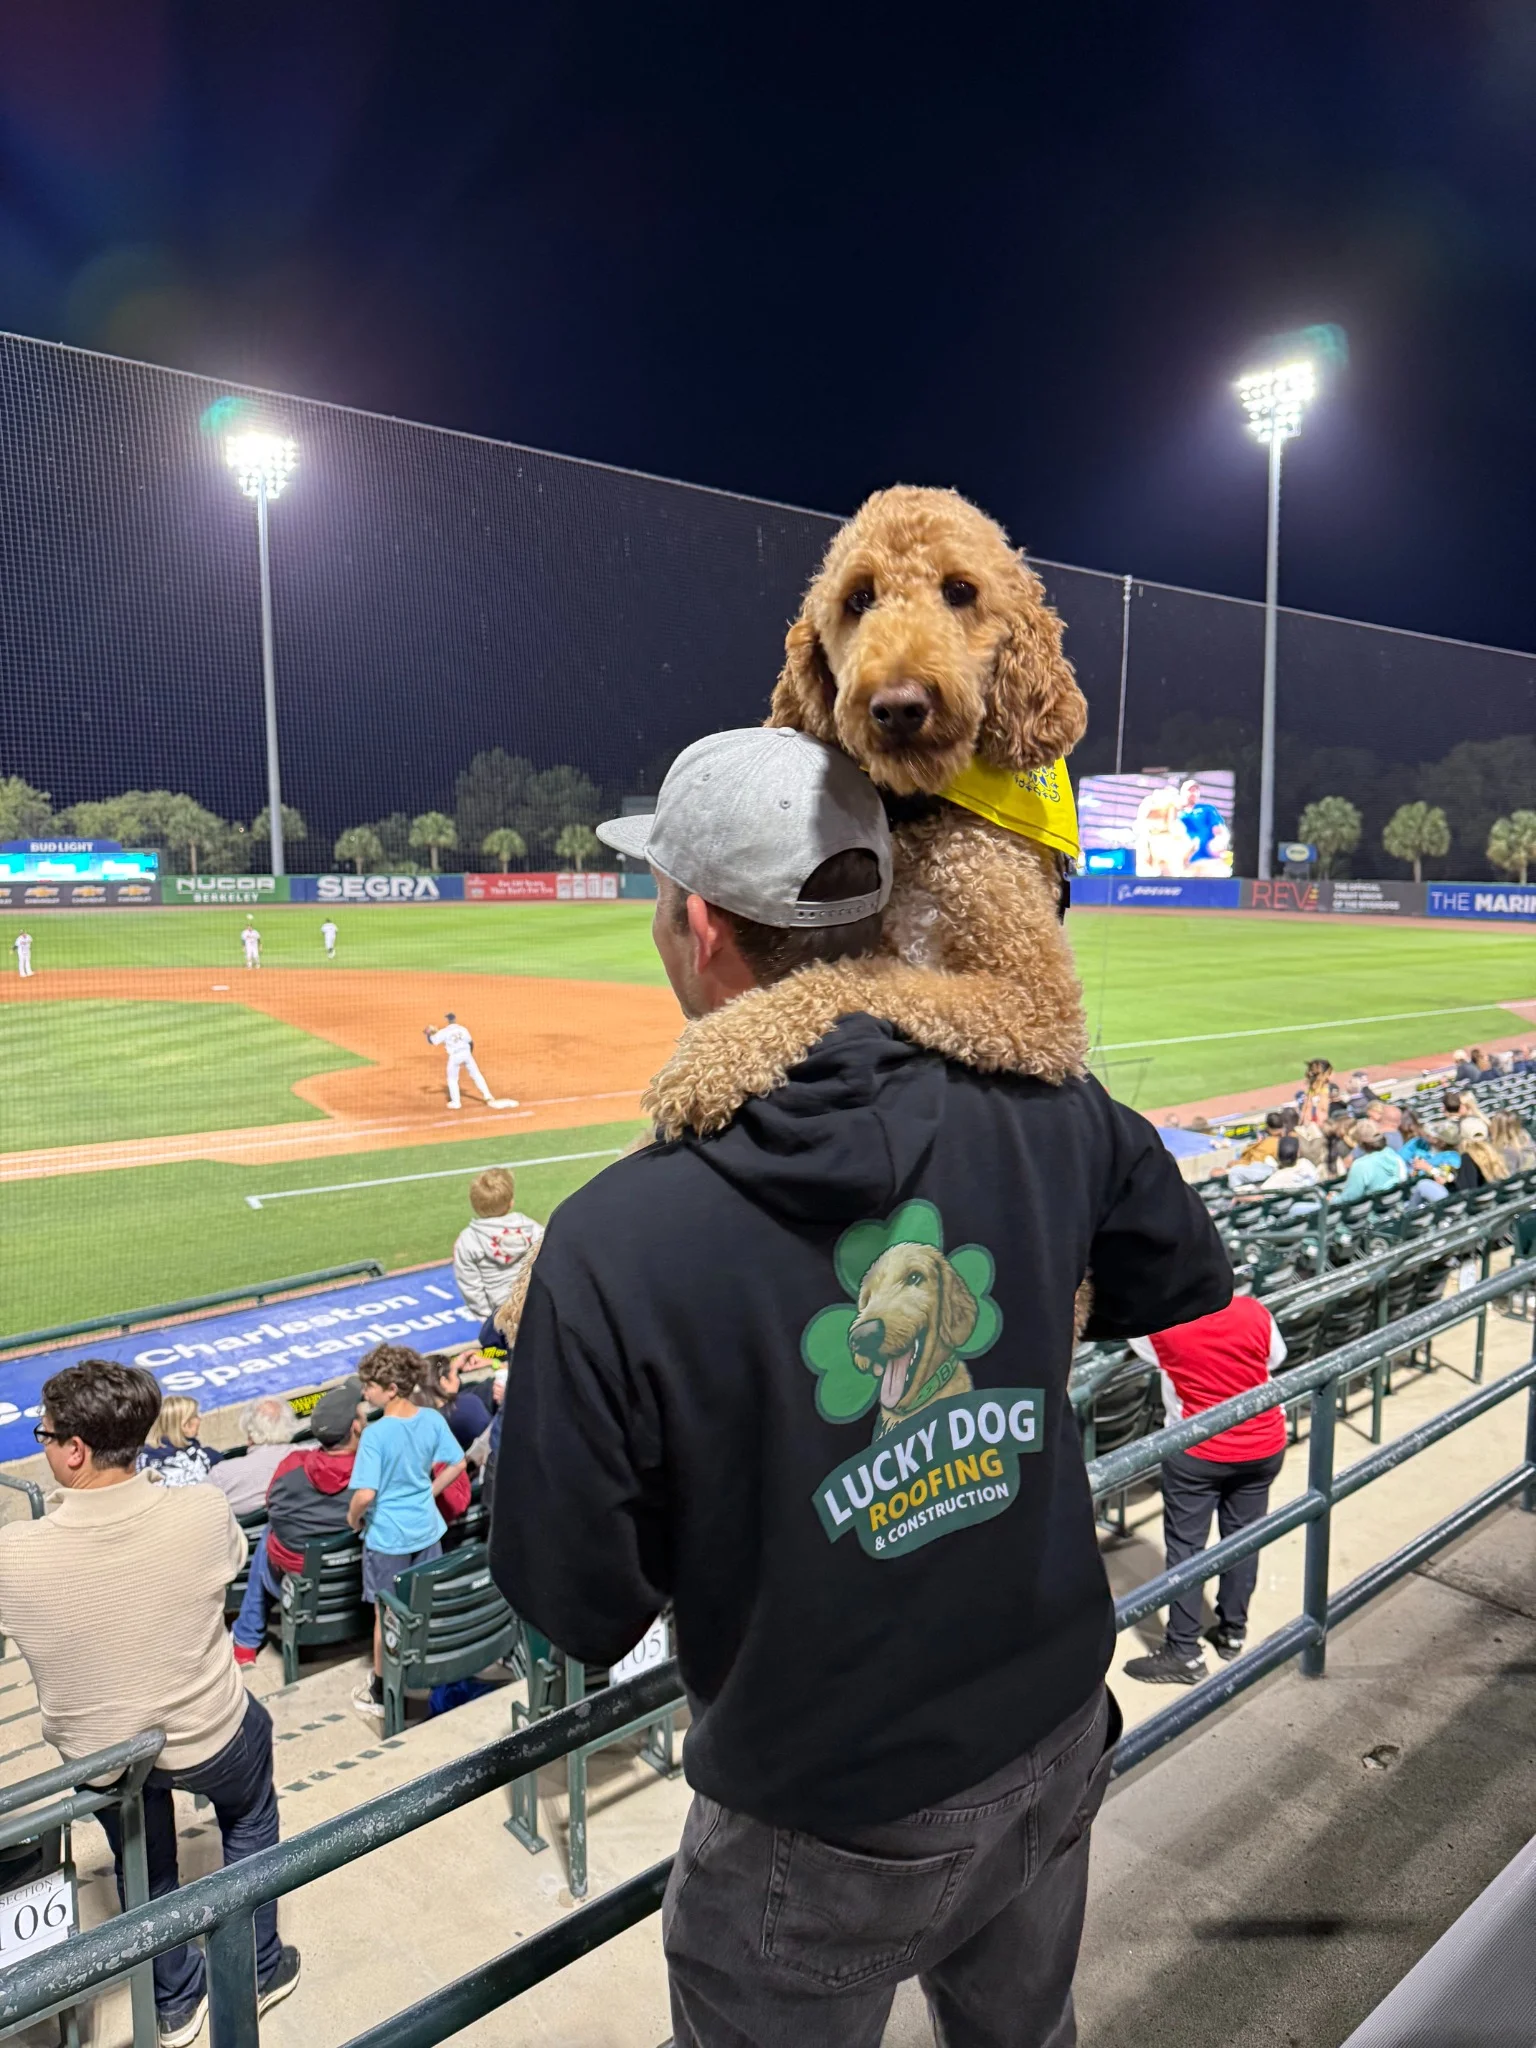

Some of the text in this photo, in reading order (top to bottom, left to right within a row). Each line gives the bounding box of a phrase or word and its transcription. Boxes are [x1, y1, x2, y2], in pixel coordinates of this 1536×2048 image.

[30, 841, 94, 853] BUD LIGHT
[176, 876, 276, 891] NUCOR
[317, 875, 440, 898] SEGRA
[193, 892, 259, 903] BERKELEY
[1431, 892, 1471, 911] THE
[134, 1294, 419, 1368] Charleston
[824, 1400, 1036, 1526] LUCKY DOG
[868, 1448, 1005, 1532] ROOFING
[874, 1482, 1010, 1551] & CONSTRUCTION
